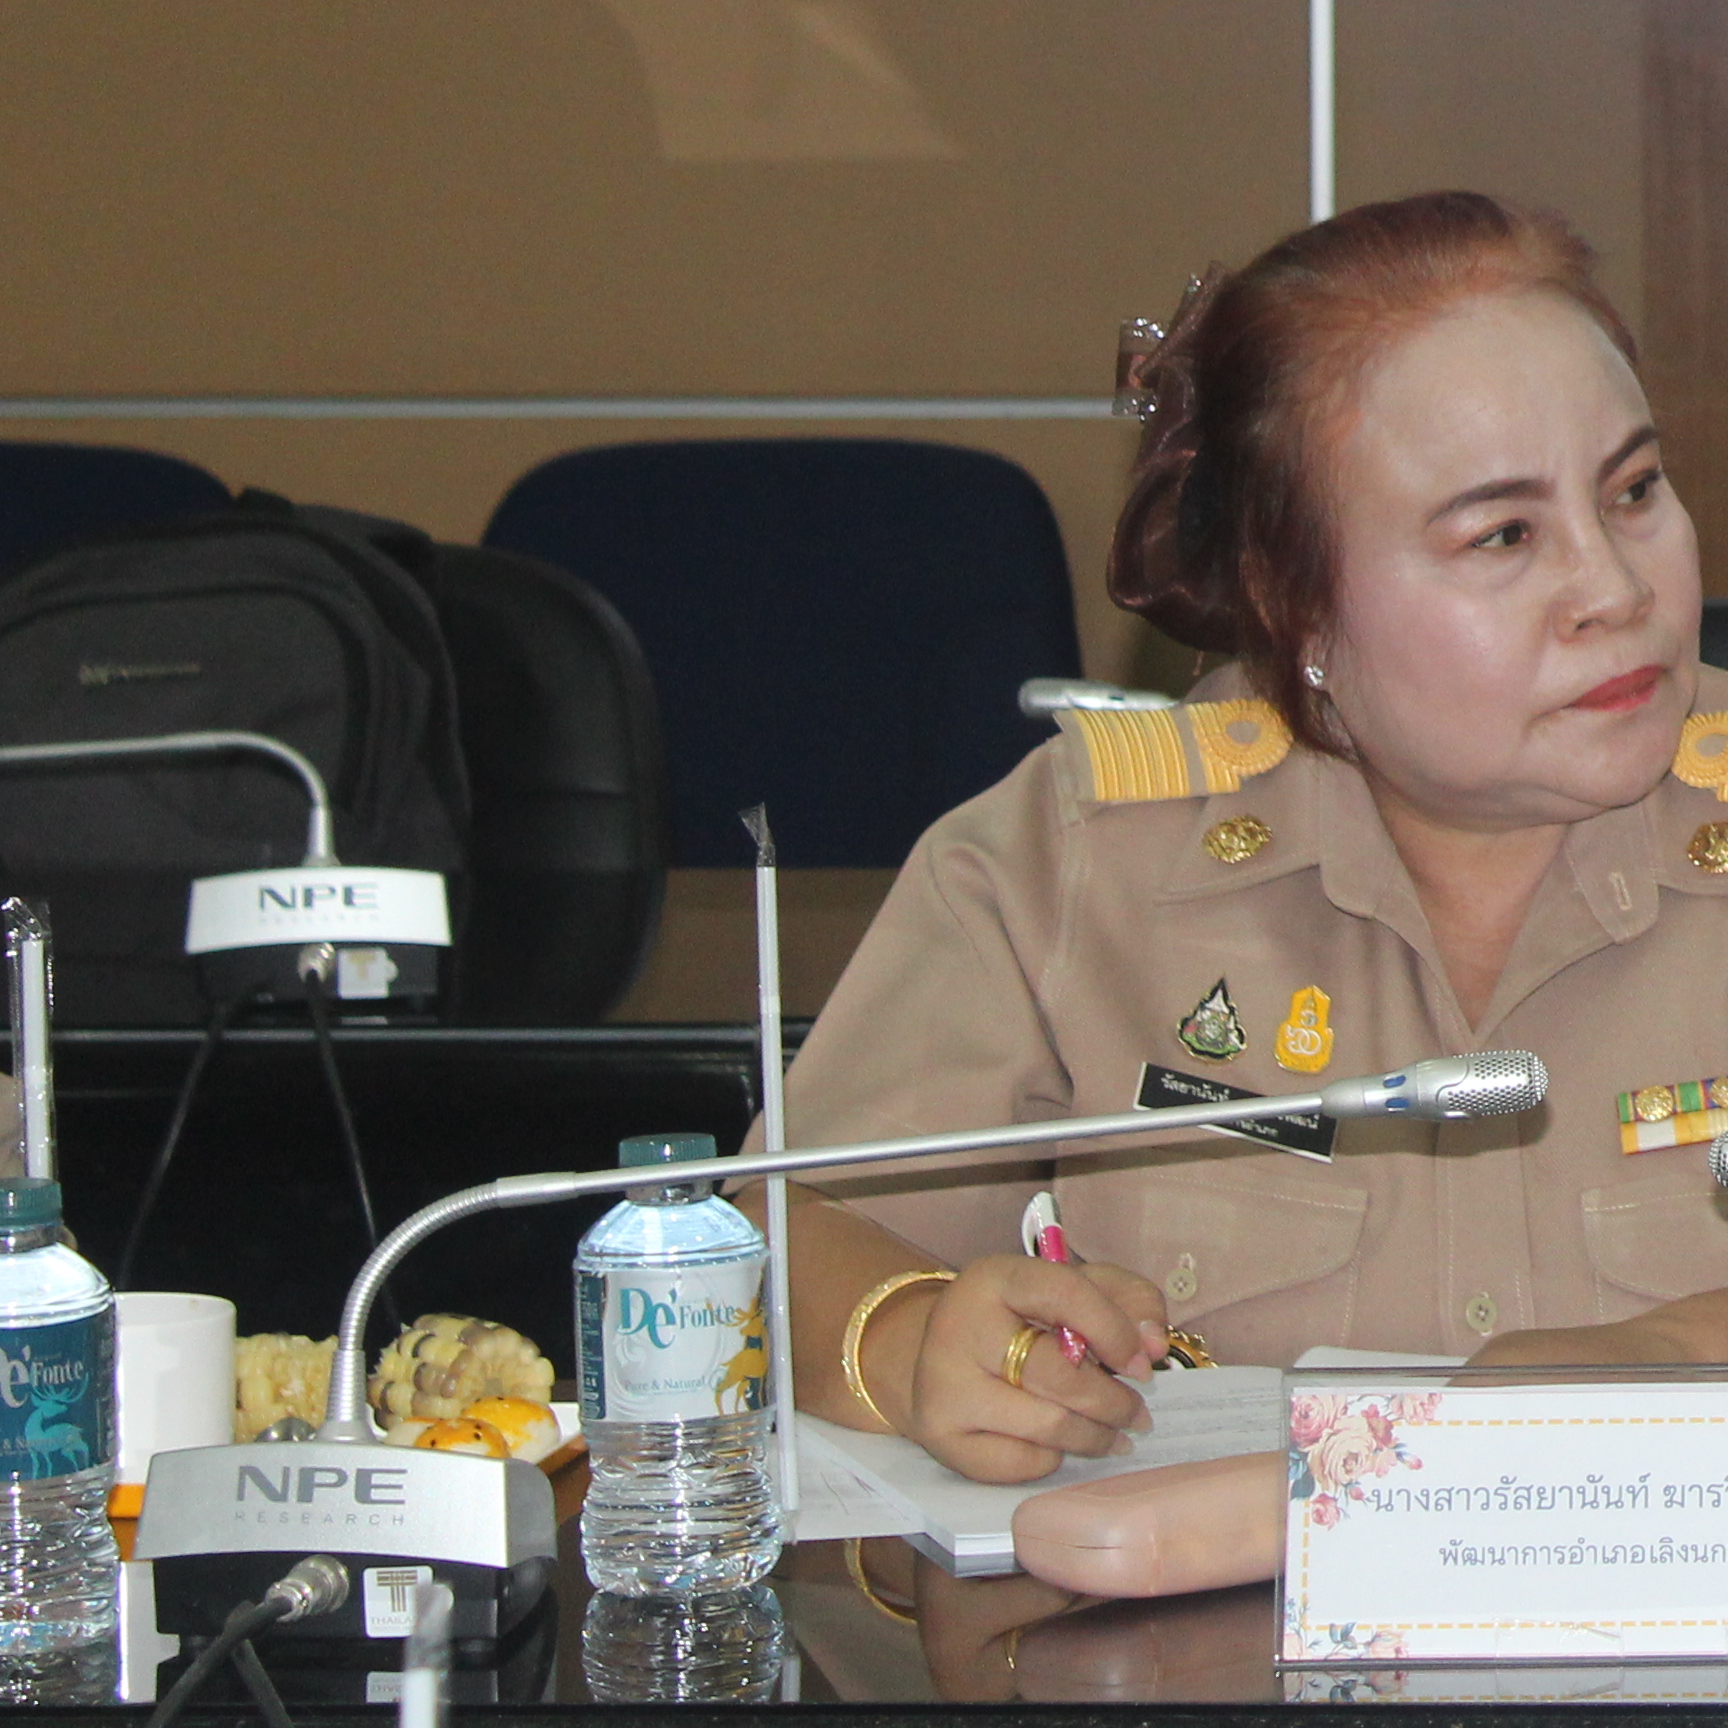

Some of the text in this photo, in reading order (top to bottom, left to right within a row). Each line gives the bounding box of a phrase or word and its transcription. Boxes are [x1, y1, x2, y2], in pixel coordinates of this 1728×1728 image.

[258, 881, 380, 912] NPE
[236, 1464, 409, 1506] NPE
[1370, 1471, 1651, 1515] นางสาวรัสยานันท์
[233, 1510, 405, 1527] RESEARCH
